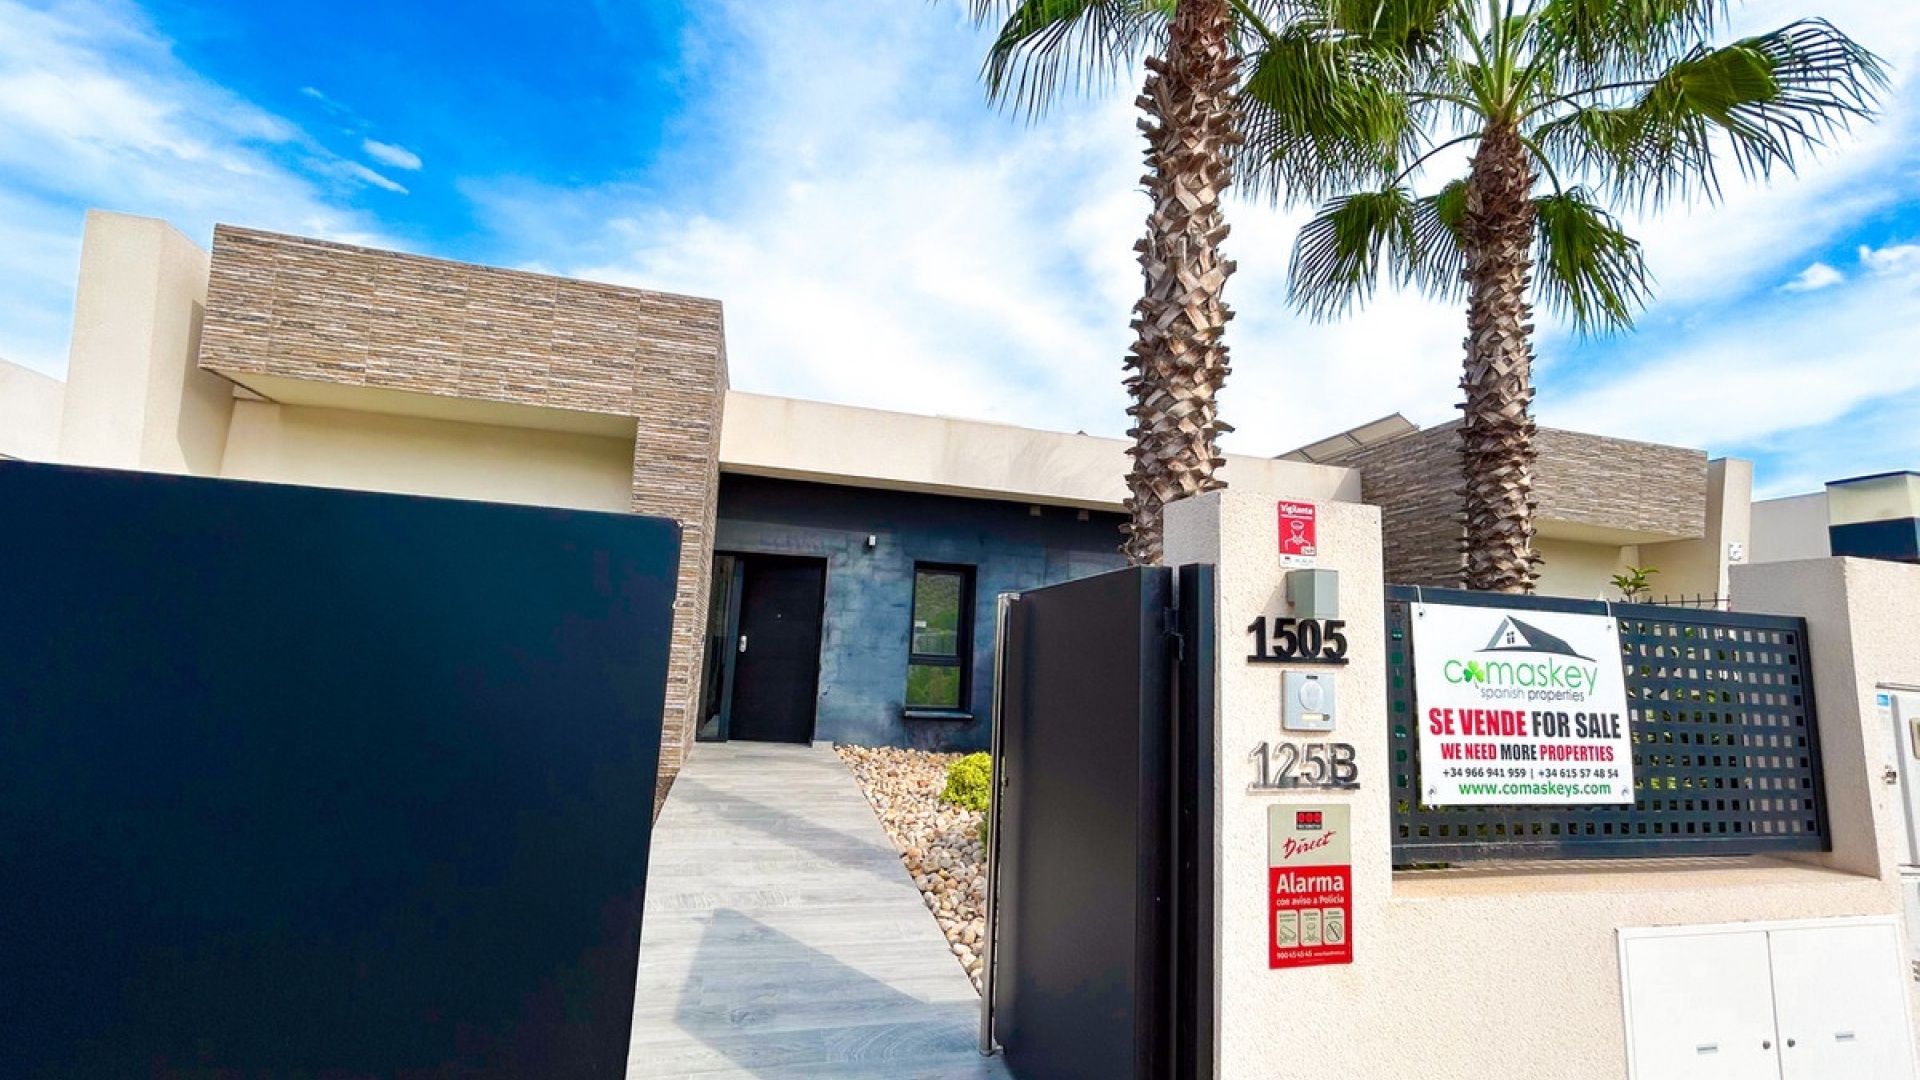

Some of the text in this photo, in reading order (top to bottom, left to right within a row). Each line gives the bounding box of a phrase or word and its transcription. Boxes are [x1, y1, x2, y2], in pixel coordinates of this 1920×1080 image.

[1247, 616, 1348, 660] 1505
[1481, 687, 1585, 703] spanish properties
[1429, 708, 1621, 739] SE VENDE FOR SALE
[1440, 743, 1614, 762] WE NEED MORE PROPERTIES
[1249, 741, 1360, 789] 125B
[1442, 767, 1463, 778] +34
[1465, 767, 1484, 778] 966
[1486, 767, 1505, 778] 941
[1508, 768, 1526, 778] 959
[1538, 769, 1557, 779] +34
[1559, 769, 1577, 779] 615
[1579, 769, 1591, 779] 57
[1593, 769, 1606, 779] 48
[1607, 769, 1619, 779] 54
[1458, 781, 1612, 798] www.comaskeys.com
[1282, 830, 1336, 860] Direct
[1276, 872, 1344, 894] Alarma
[1292, 897, 1312, 905] aviso
